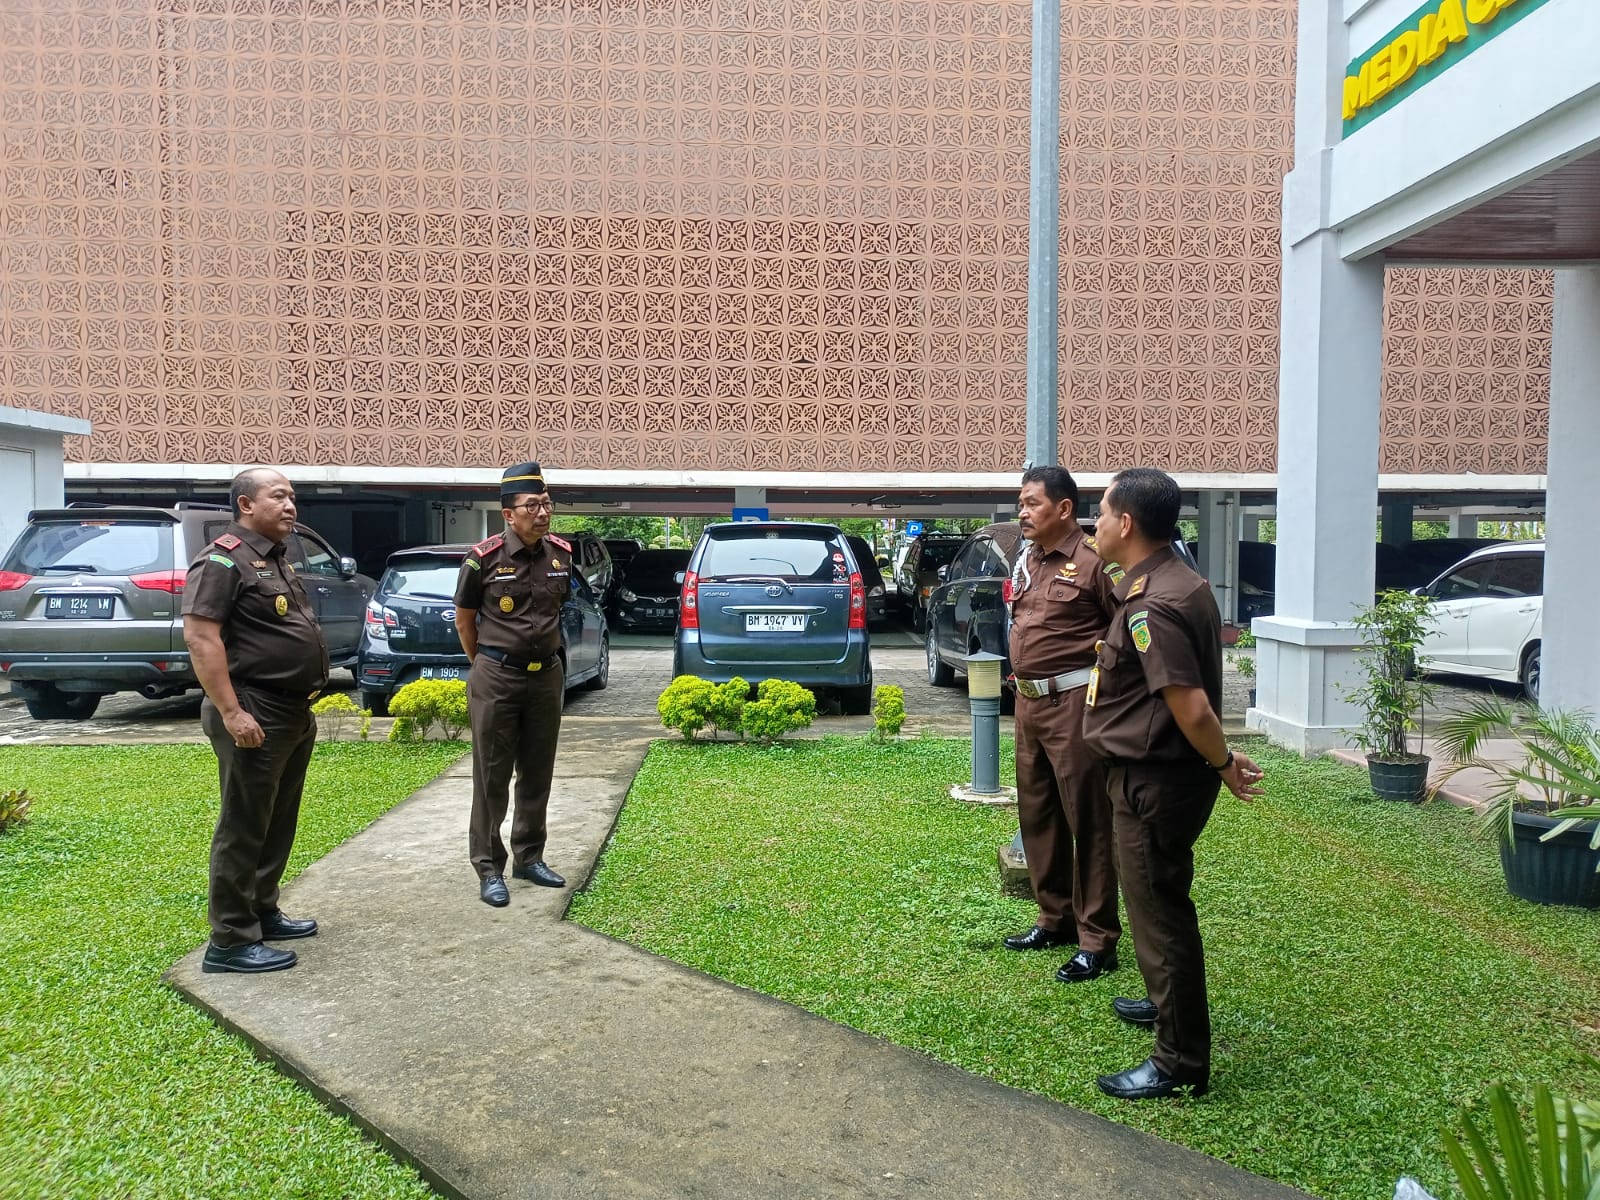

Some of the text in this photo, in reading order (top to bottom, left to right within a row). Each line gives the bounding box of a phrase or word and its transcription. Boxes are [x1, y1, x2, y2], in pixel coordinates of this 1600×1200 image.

[1342, 0, 1468, 120] MEDIA
[910, 525, 919, 534] P
[50, 598, 62, 609] BM
[70, 598, 88, 609] 1214
[748, 615, 804, 626] BM 1947 VY
[440, 667, 460, 677] 1905
